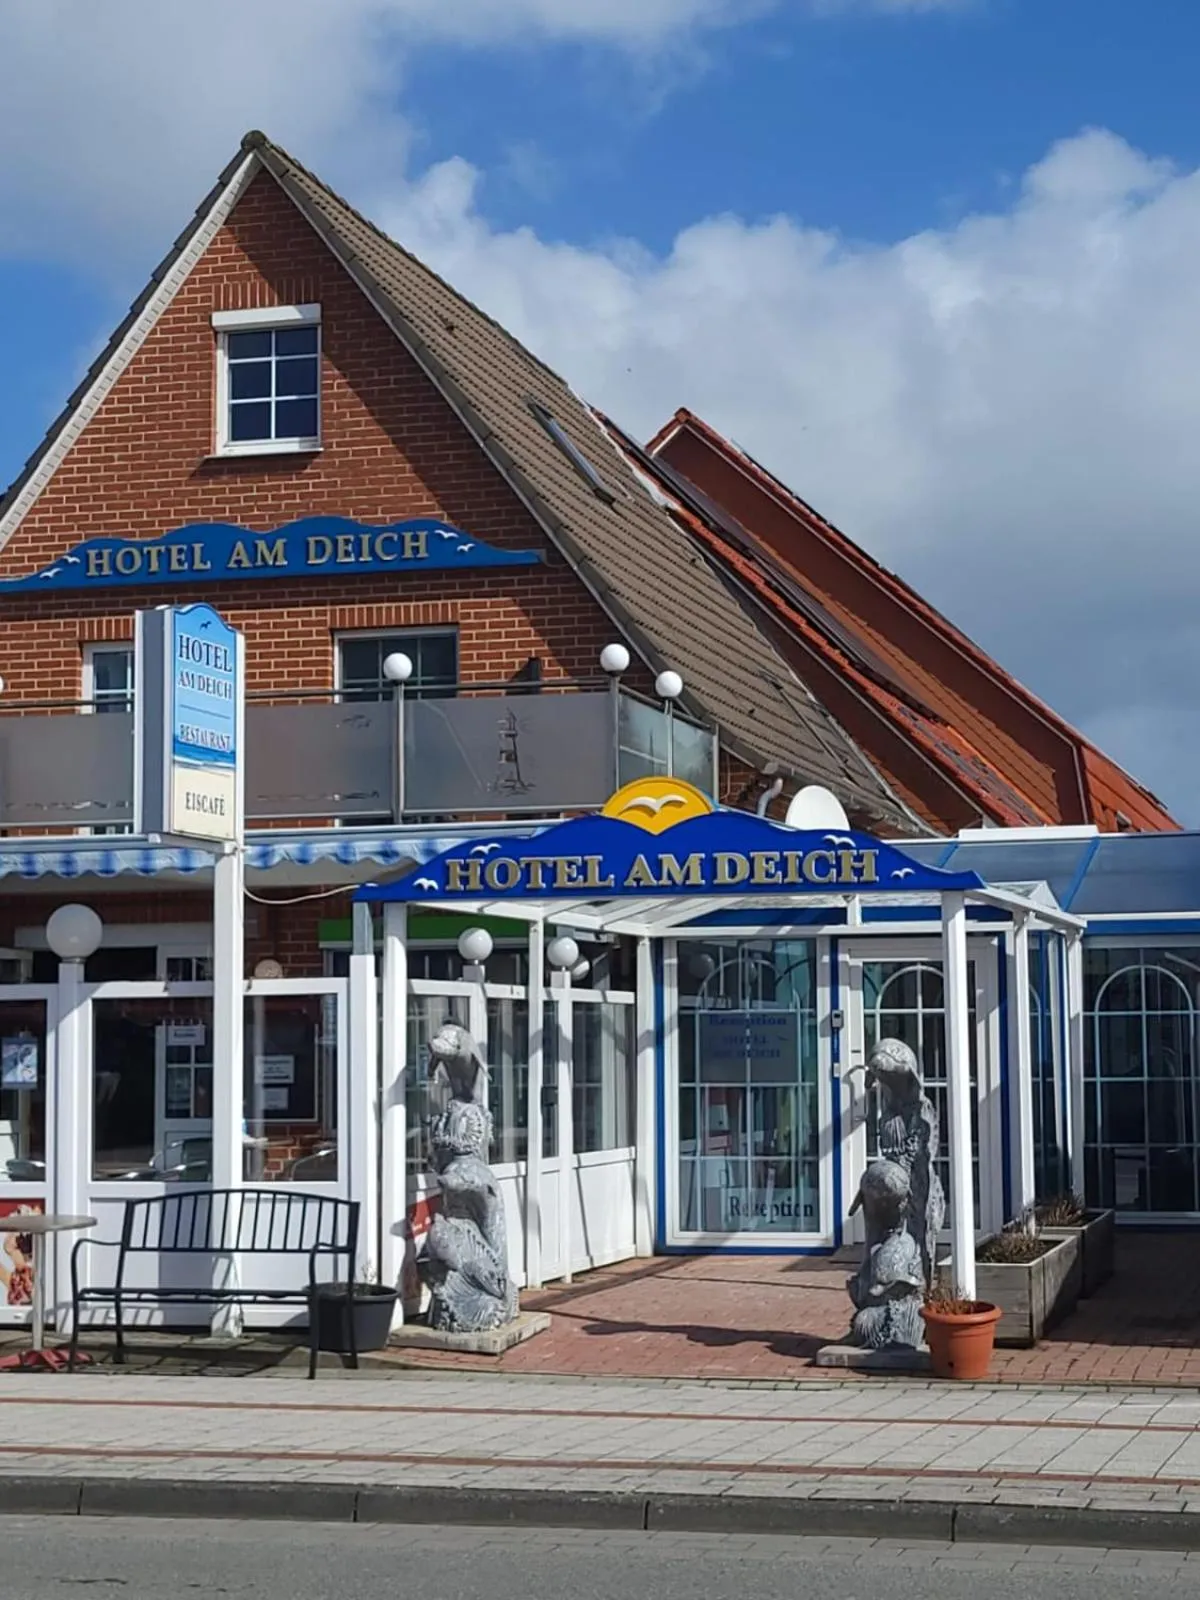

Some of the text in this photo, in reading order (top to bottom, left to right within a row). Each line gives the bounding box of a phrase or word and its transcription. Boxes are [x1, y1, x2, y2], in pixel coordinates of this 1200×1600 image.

[86, 530, 430, 577] HOTEL AM DEICH
[178, 634, 233, 673] HOTEL
[178, 671, 233, 700] AM DEICH
[180, 723, 231, 752] RESTAURANT
[445, 849, 880, 891] HOTEL AM DEICH
